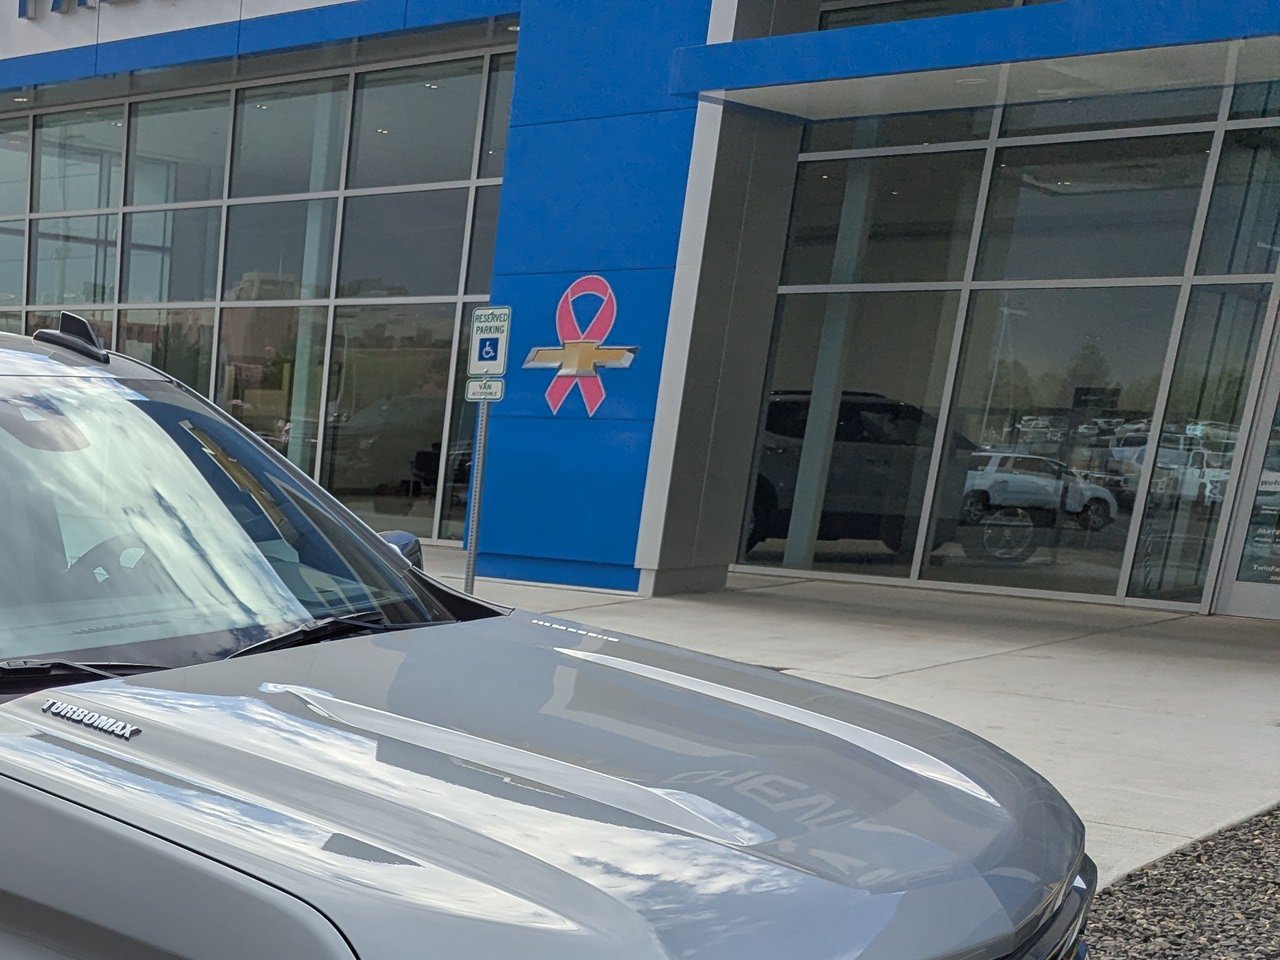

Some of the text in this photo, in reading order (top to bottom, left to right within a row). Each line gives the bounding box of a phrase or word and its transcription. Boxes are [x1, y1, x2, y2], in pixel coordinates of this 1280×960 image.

[475, 313, 508, 323] RESERVED
[476, 325, 505, 335] PARKING
[478, 383, 492, 391] VAN
[42, 698, 141, 741] TURBOMAX
